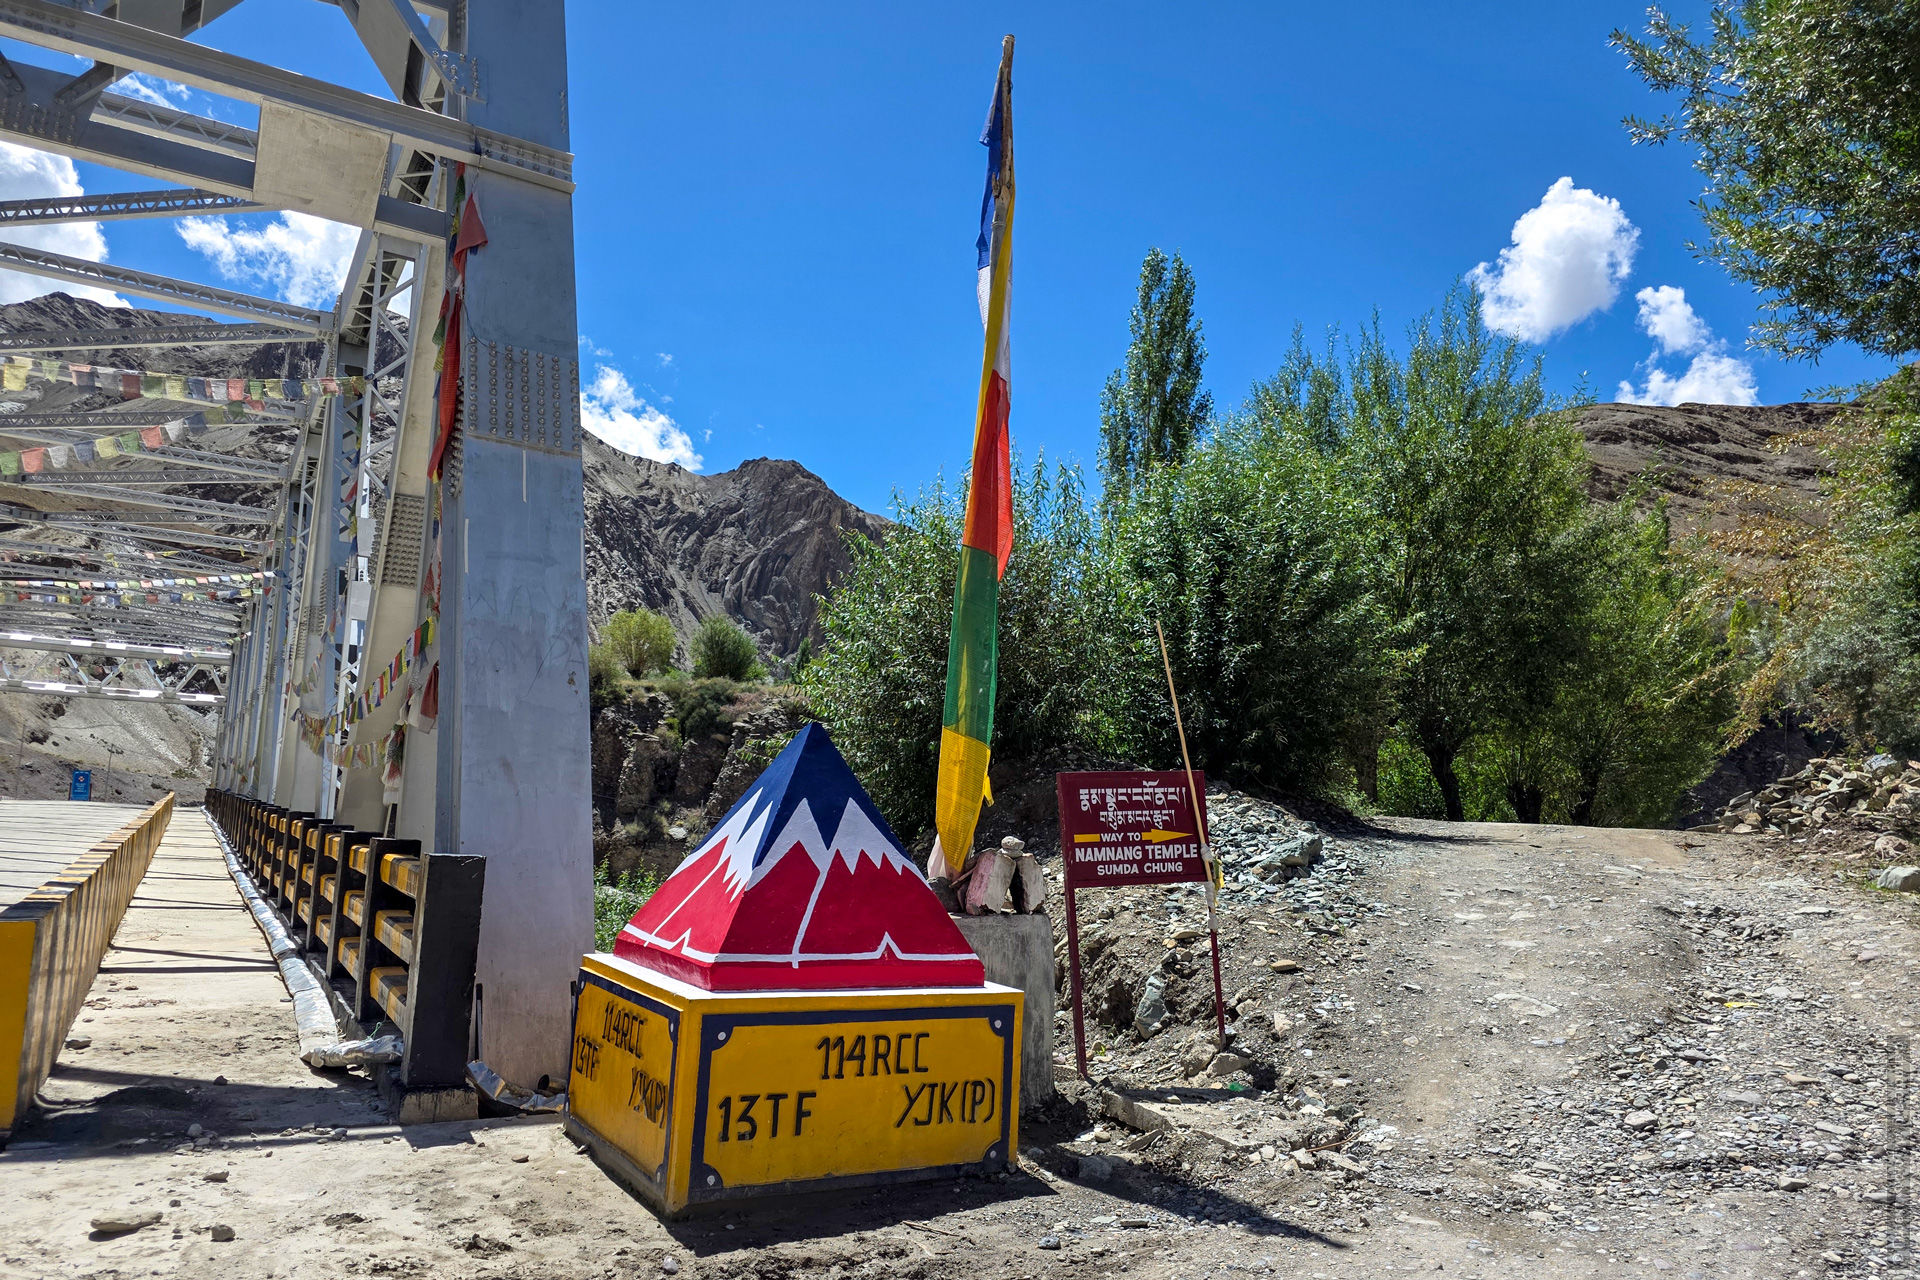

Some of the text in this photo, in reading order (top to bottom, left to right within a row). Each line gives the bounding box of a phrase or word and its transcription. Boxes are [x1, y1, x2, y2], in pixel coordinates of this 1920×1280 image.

[1100, 832, 1141, 842] WAY TO
[1074, 843, 1198, 862] NAMNANG TEMPLE
[1097, 861, 1183, 876] SUMDA CHUNG
[895, 1078, 996, 1128] YJK(P)
